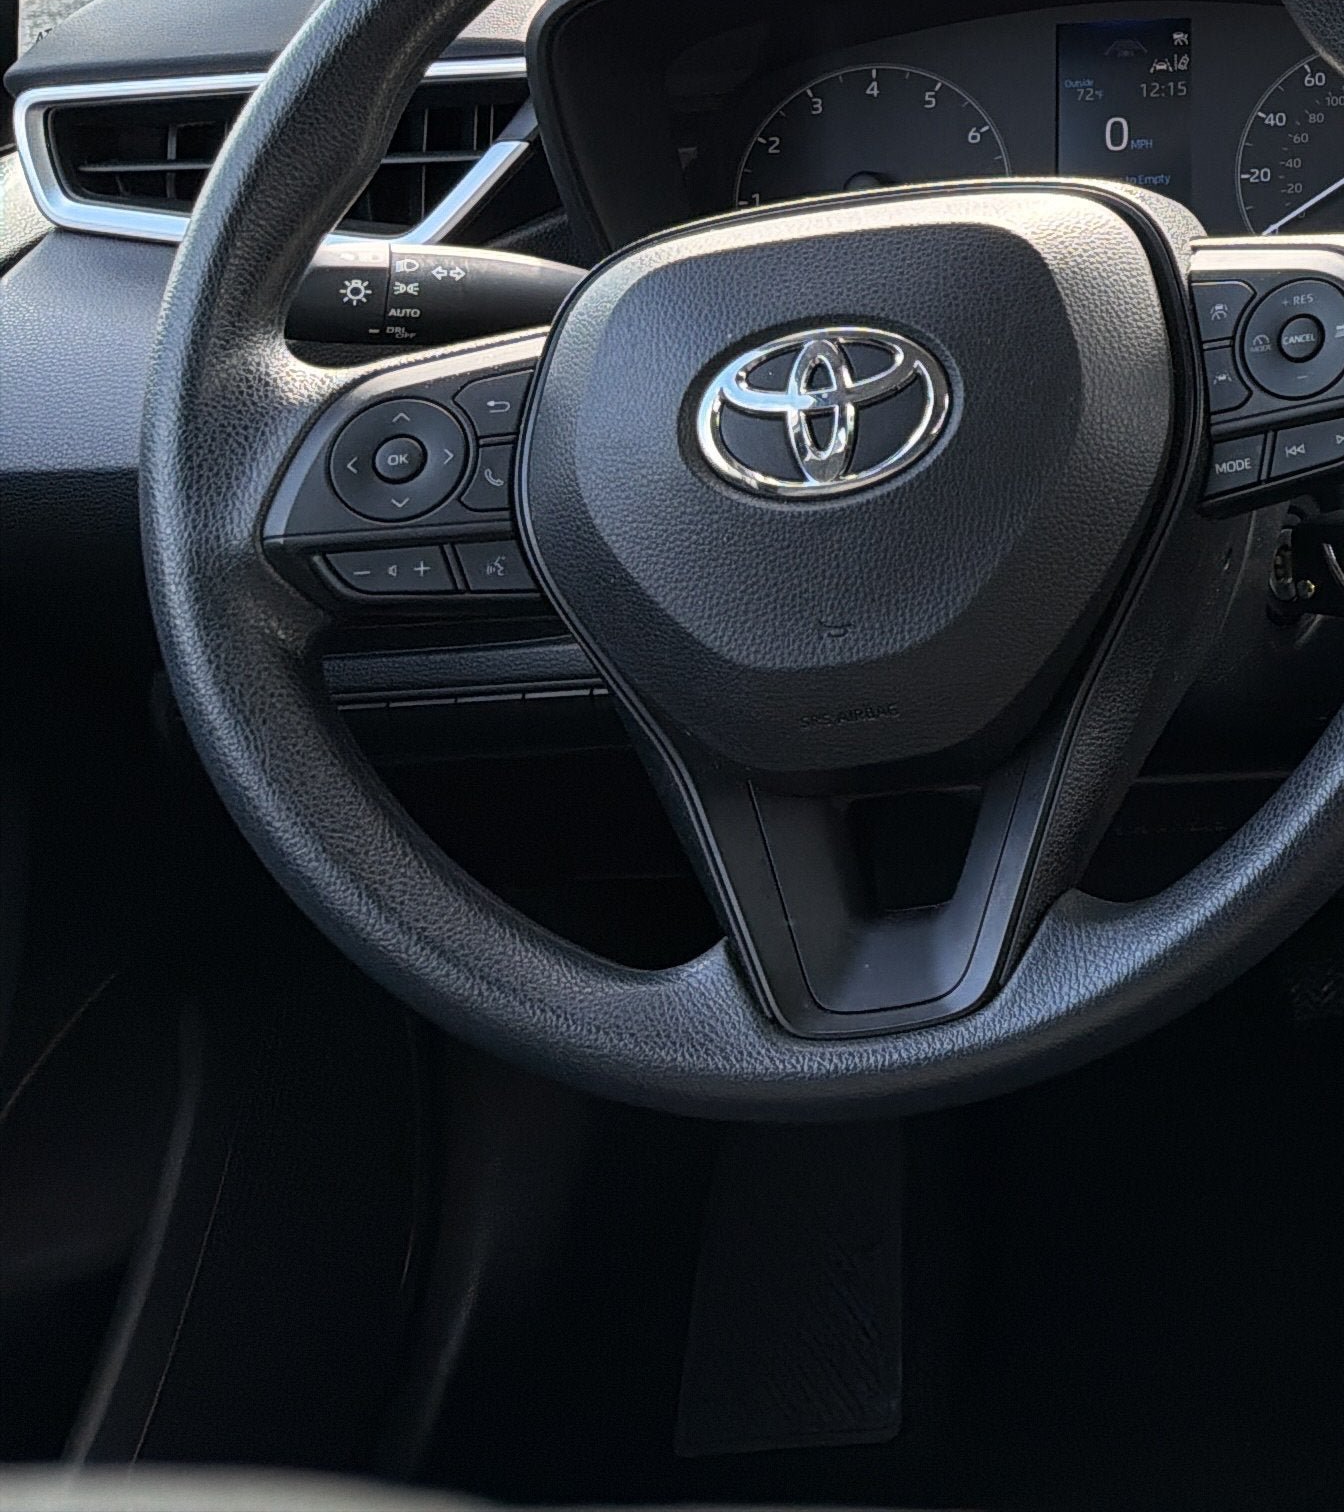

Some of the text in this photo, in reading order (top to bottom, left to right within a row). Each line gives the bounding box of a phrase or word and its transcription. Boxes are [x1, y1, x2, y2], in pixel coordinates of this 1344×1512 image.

[1064, 79, 1094, 88] Outside
[1304, 72, 1326, 86] 60
[866, 82, 880, 97] 4
[1140, 81, 1187, 98] 12:15
[811, 98, 823, 115] 3
[924, 92, 936, 108] 5
[1264, 112, 1286, 126] 40
[1308, 113, 1325, 124] 80
[968, 127, 981, 143] 6
[1106, 117, 1153, 151] 0 MPH
[1293, 133, 1310, 143] 60
[768, 137, 780, 153] 2
[1285, 158, 1302, 169] 40
[1139, 173, 1171, 186] Empty
[1249, 168, 1271, 183] 20
[1287, 183, 1303, 194] 20
[752, 193, 760, 206] 1
[388, 309, 421, 318] AUTO
[1282, 333, 1316, 346] CANCEL
[387, 453, 409, 466] OK
[1215, 457, 1252, 475] MODE
